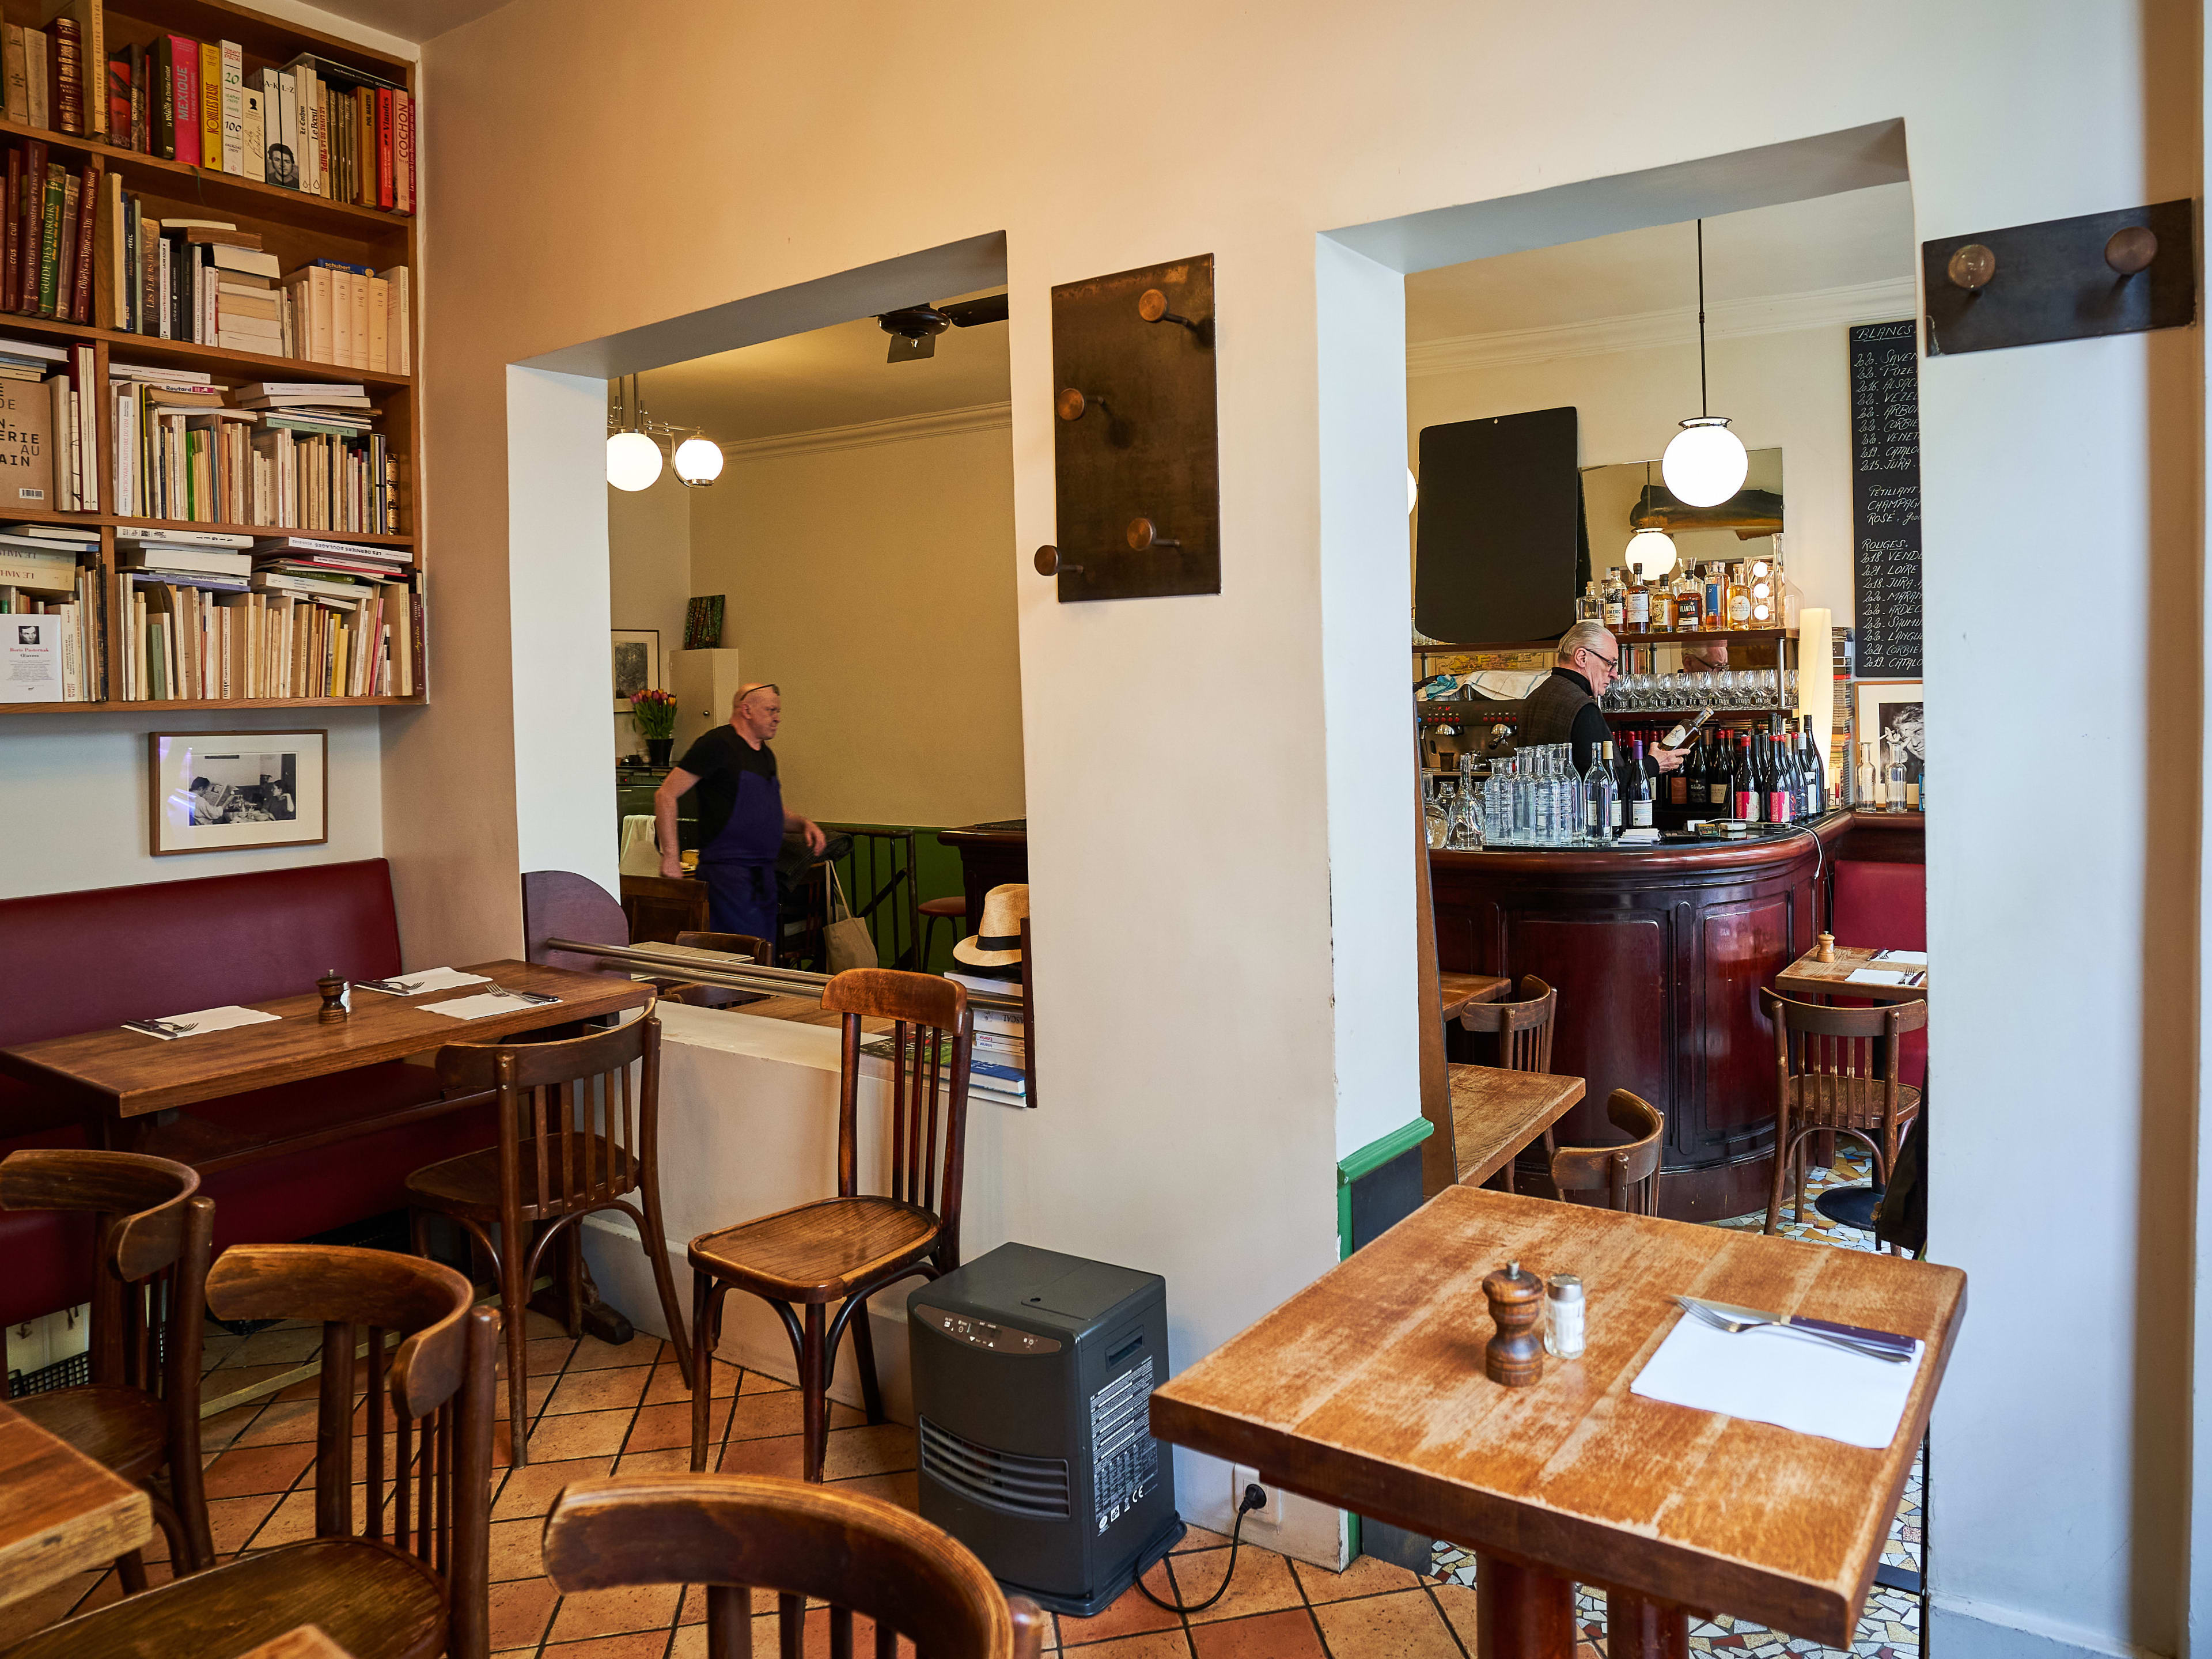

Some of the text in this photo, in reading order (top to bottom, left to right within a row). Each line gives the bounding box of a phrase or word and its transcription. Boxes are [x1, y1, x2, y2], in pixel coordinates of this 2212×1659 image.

[96, 59, 101, 67] DE
[224, 72, 240, 85] 20
[205, 82, 218, 101] D'ASIE
[264, 81, 279, 90] A-K
[282, 84, 294, 93] L-Z
[177, 65, 189, 121] MEXIQUE
[206, 100, 219, 135] NOUILLES
[381, 97, 390, 131] Viandes
[224, 121, 242, 132] 100
[398, 103, 408, 158] COCHON
[311, 129, 319, 141] Le
[86, 171, 96, 210] François Morel
[82, 217, 93, 229] Vin
[41, 203, 55, 293] GUIDE DES TERROIRS
[80, 239, 92, 258] Vigne
[324, 262, 351, 271] schubert
[146, 264, 155, 292] FLEURS
[146, 294, 155, 309] LES
[21, 444, 40, 456] AU
[315, 543, 344, 551] SOULAGES
[1887, 563, 1918, 576] LOIRE
